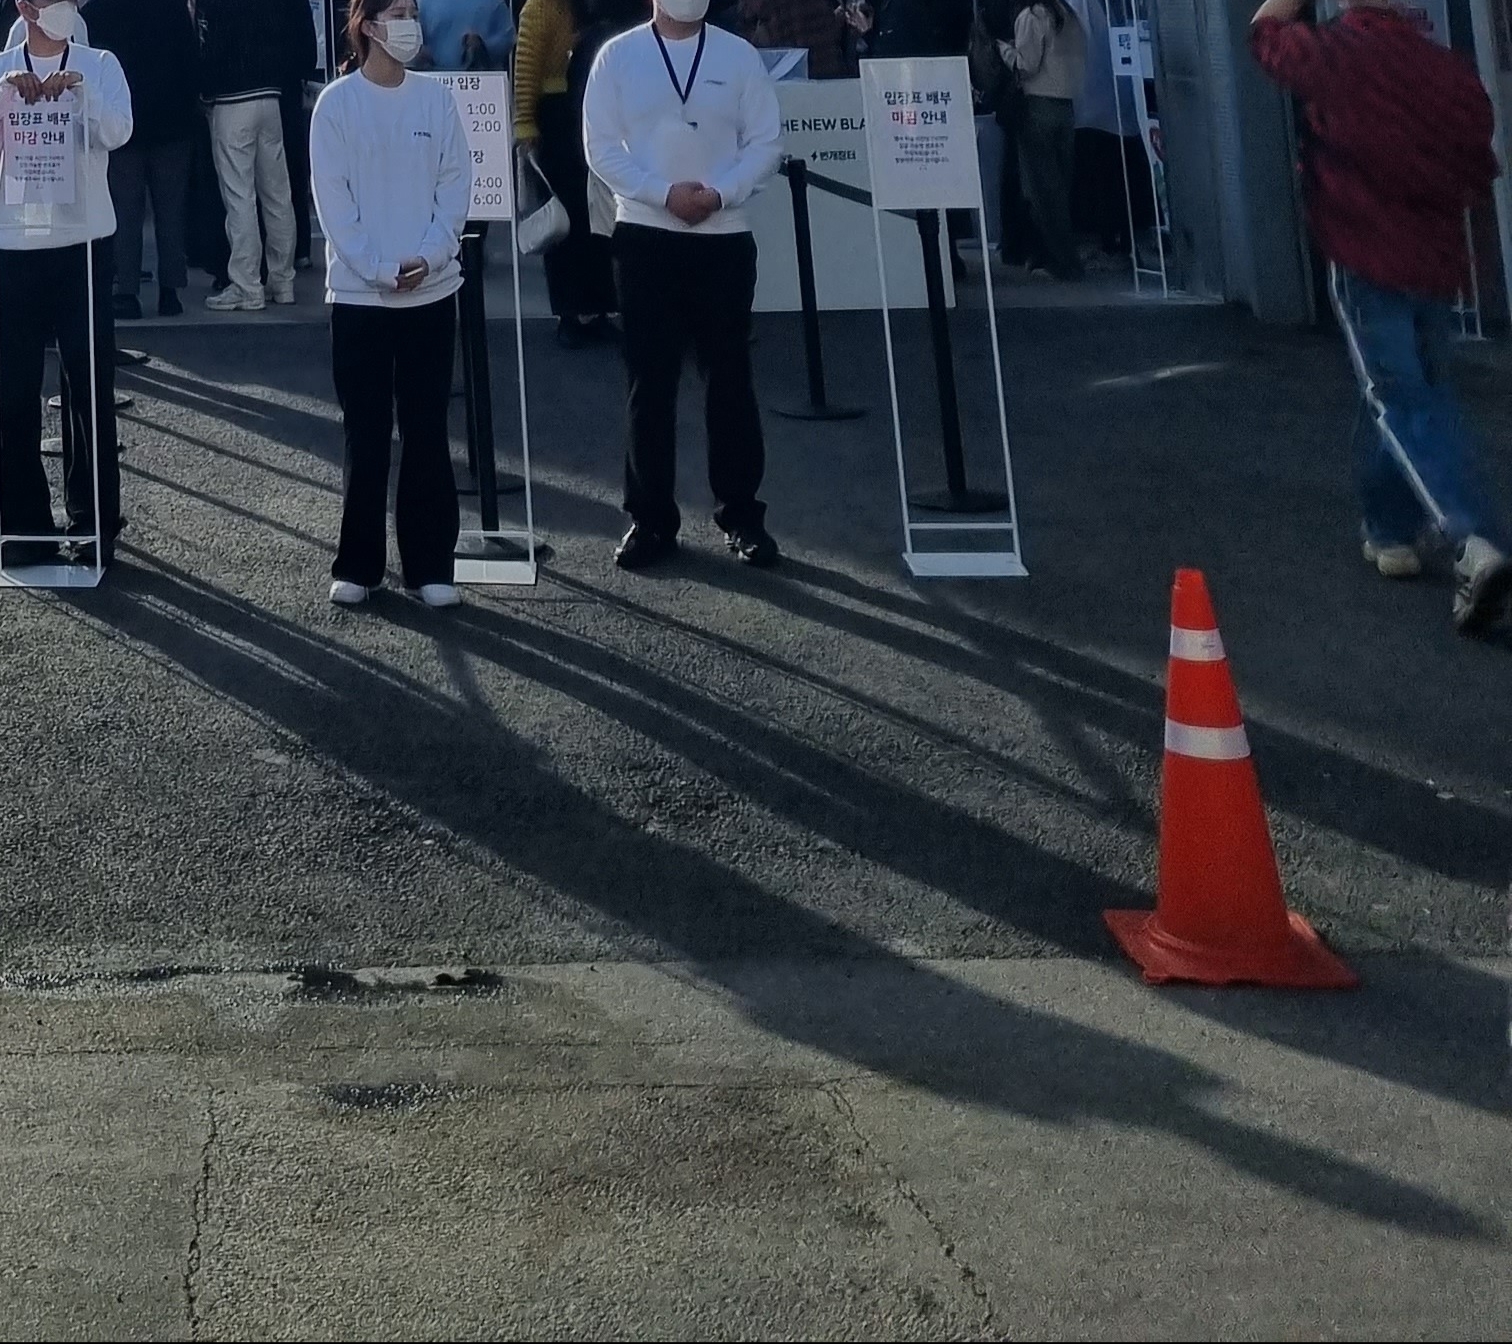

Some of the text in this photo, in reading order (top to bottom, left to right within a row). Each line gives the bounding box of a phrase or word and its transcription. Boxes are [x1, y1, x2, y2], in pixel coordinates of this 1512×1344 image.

[457, 77, 481, 91] 입장
[884, 91, 951, 105] 입장표 배부
[8, 112, 70, 126] 입장표 배부
[921, 110, 947, 125] 안내
[472, 120, 501, 132] 2:00
[801, 118, 837, 131] NEW
[14, 132, 65, 145] 마감 안내
[474, 176, 502, 188] 4:00
[473, 193, 502, 205] 6:00
